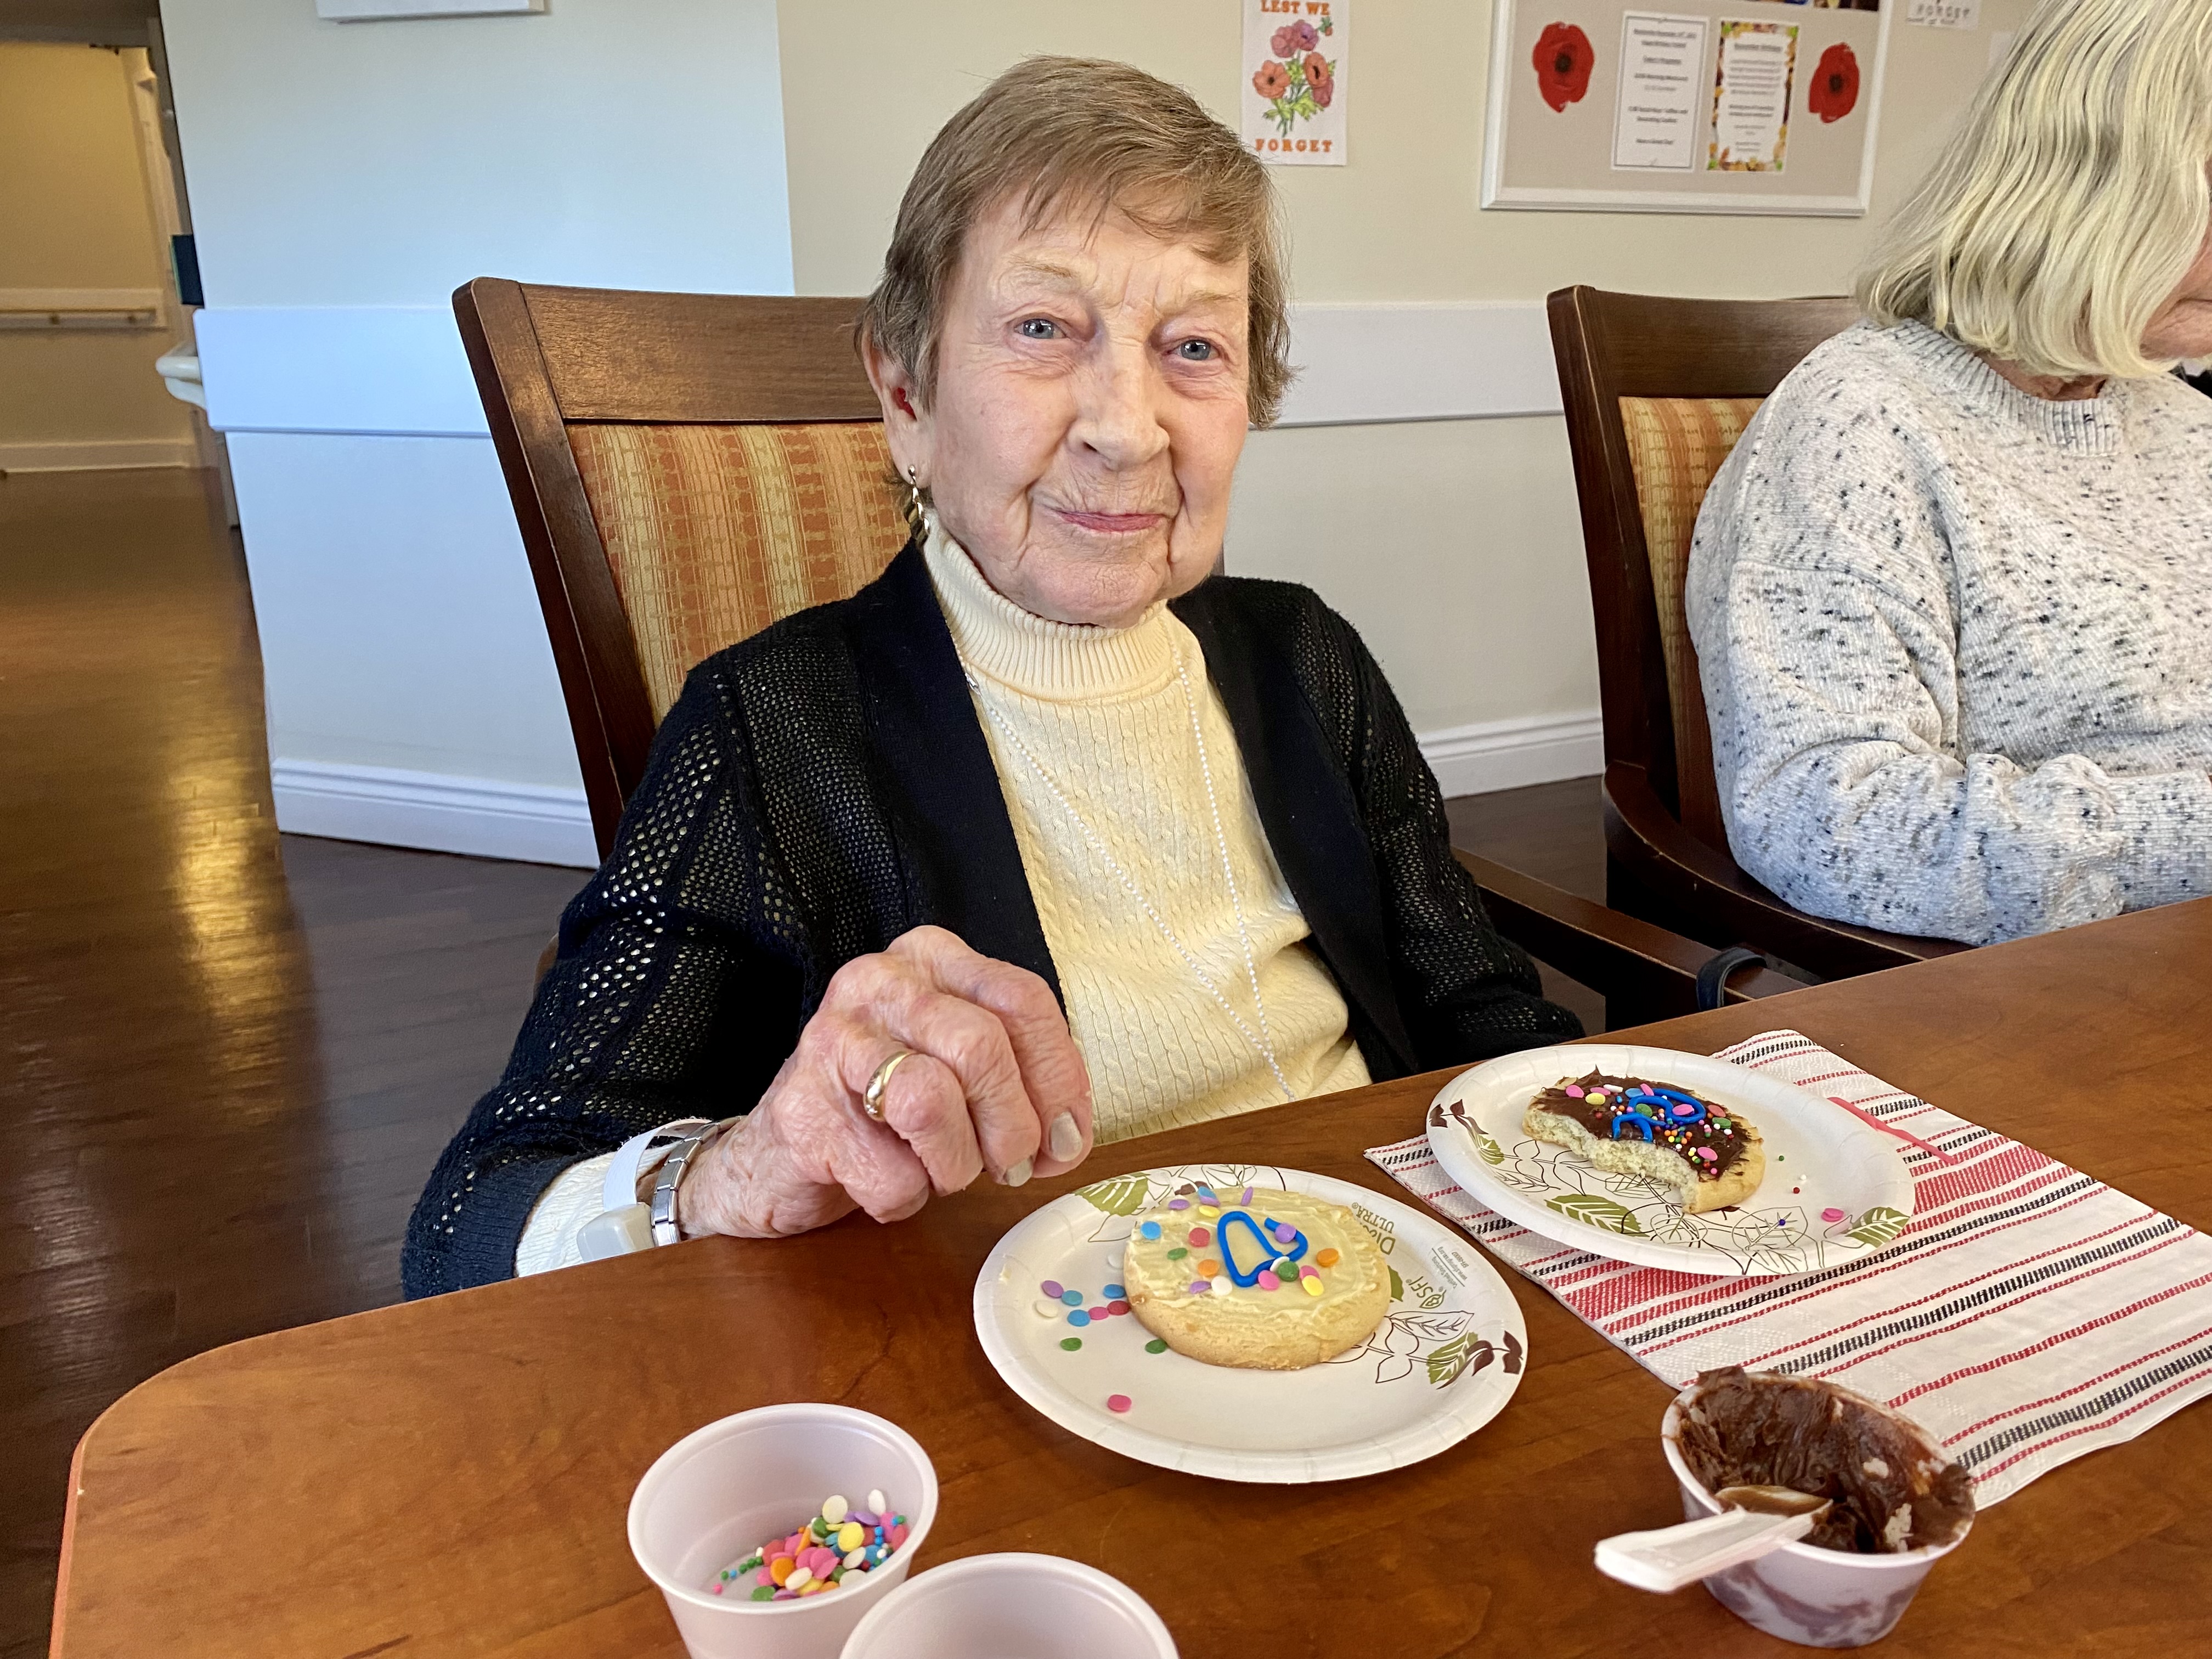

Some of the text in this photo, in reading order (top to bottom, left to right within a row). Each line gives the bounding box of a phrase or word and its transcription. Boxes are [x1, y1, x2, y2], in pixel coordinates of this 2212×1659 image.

[1261, 0, 1330, 15] LEST WE
[1255, 138, 1333, 153] FORGET
